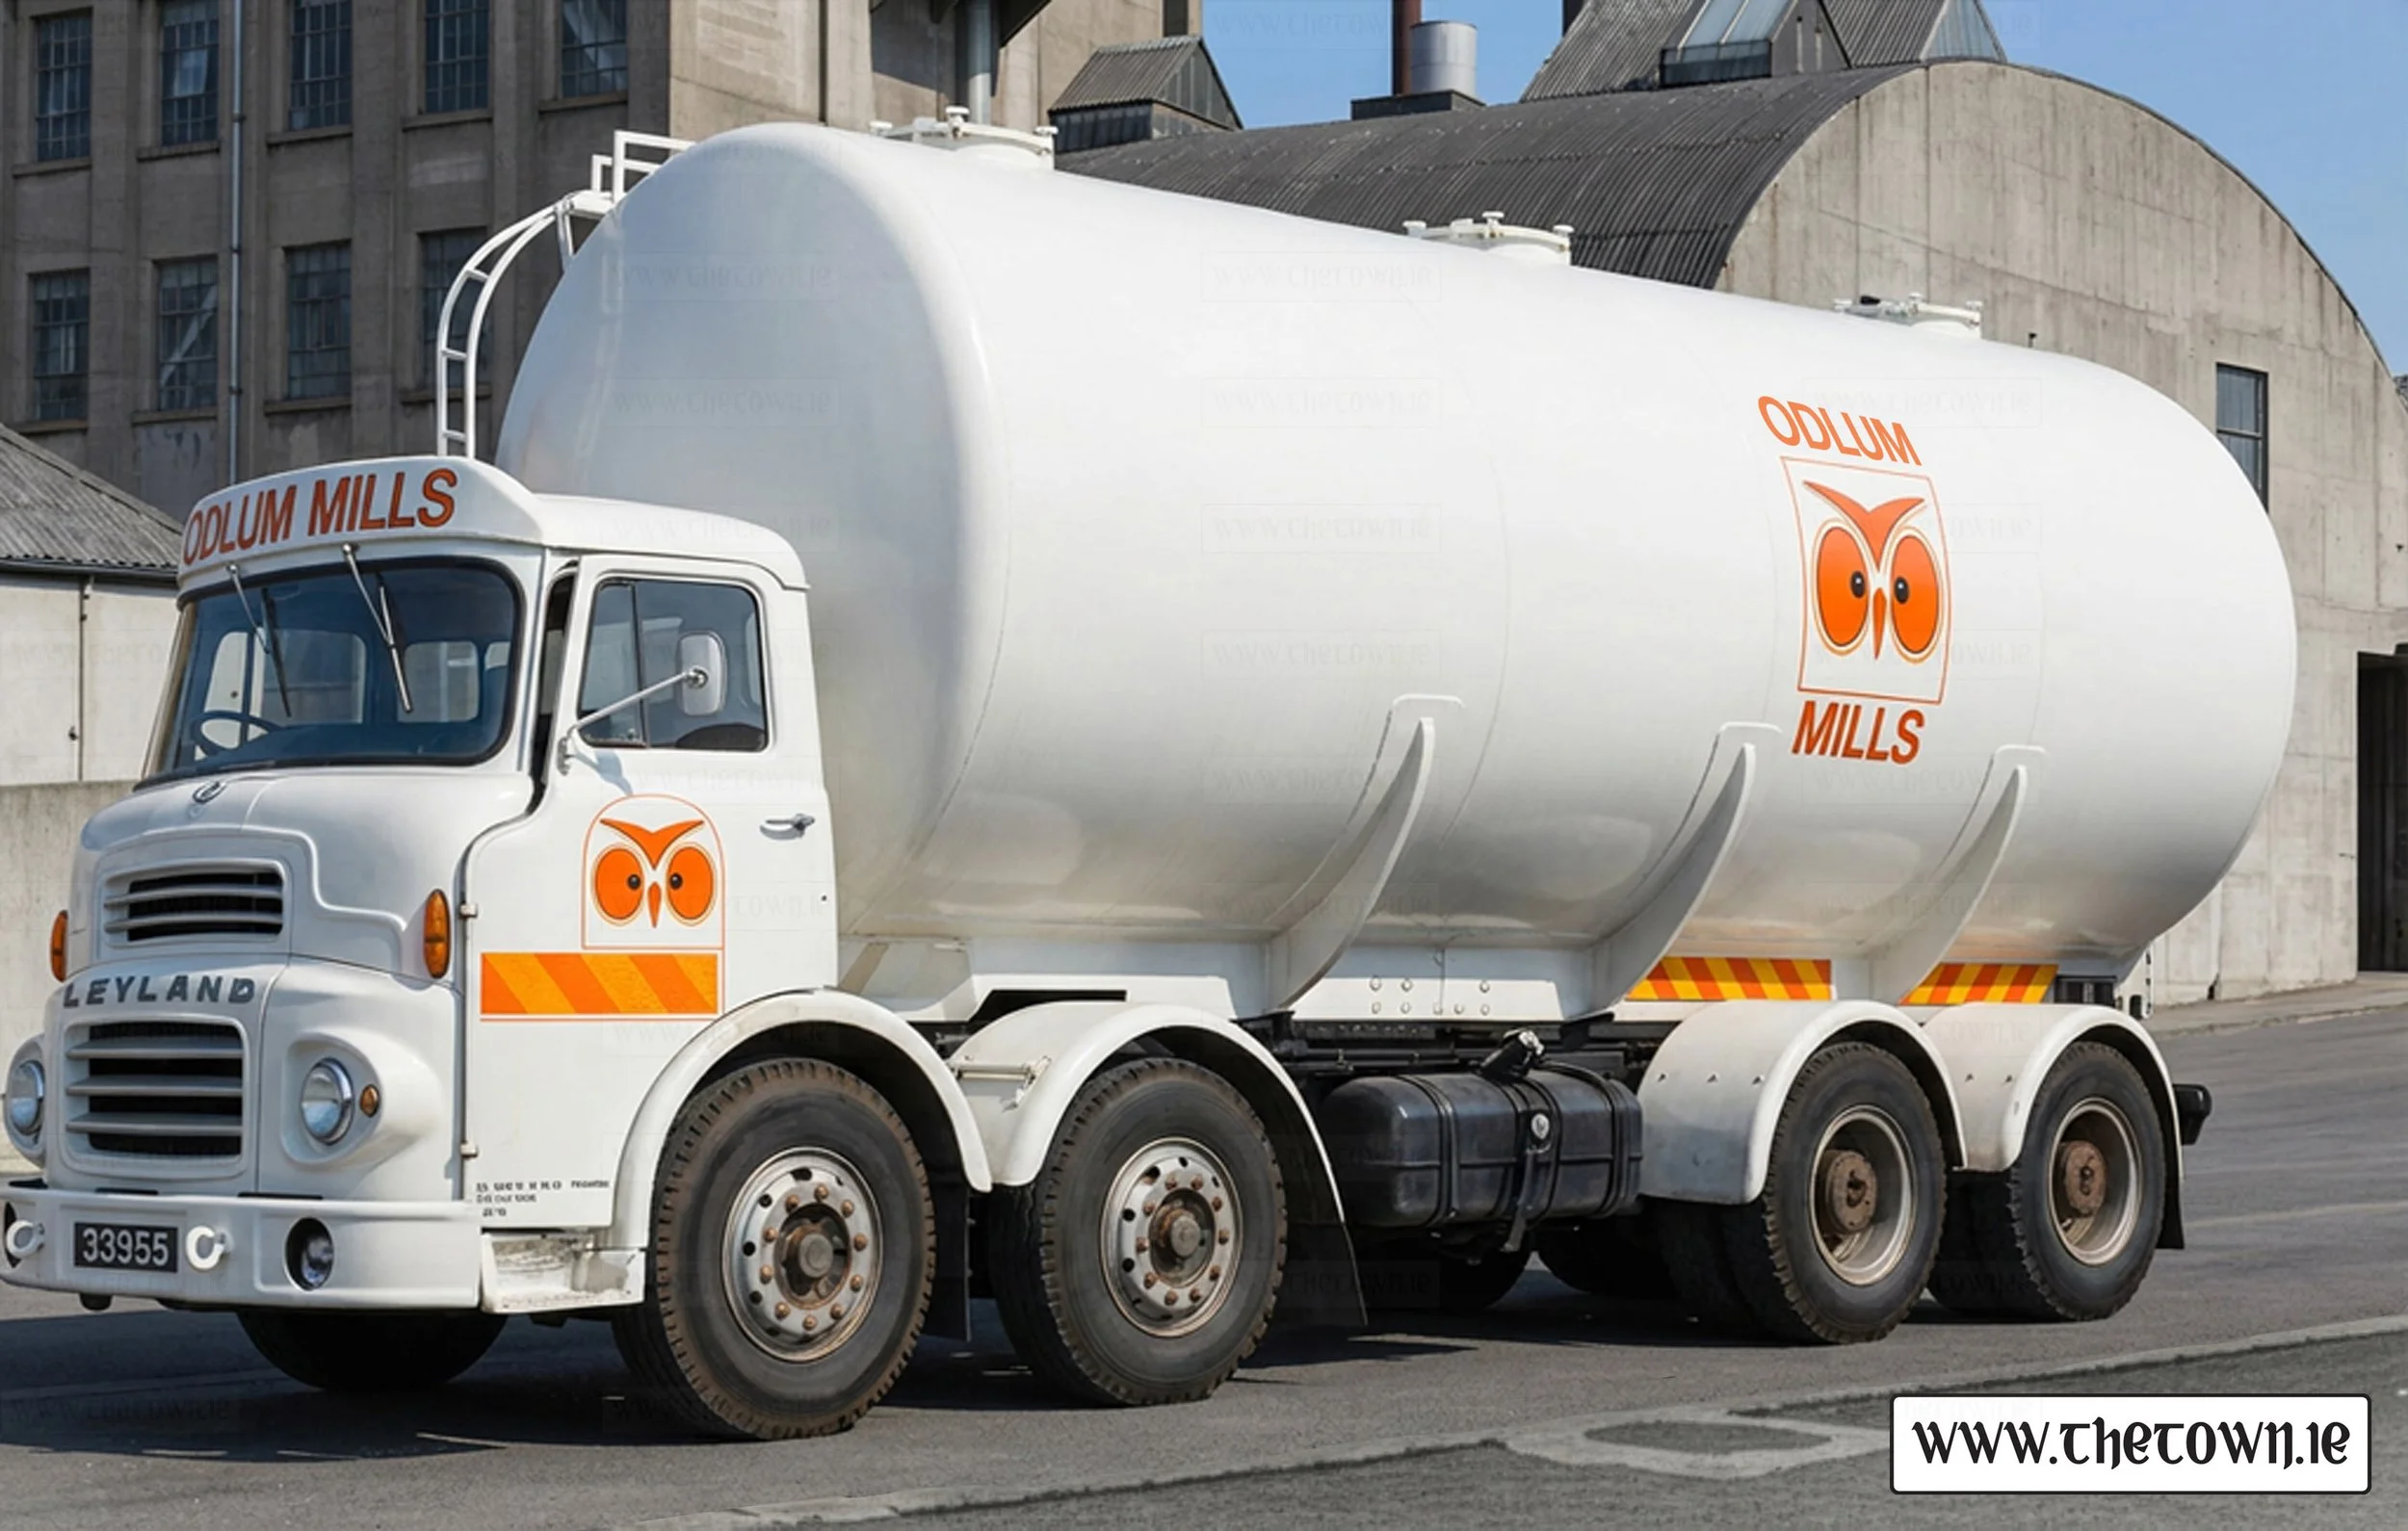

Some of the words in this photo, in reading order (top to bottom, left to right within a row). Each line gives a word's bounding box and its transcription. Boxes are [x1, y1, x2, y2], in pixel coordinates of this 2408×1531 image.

[1758, 396, 1923, 466] ODLUM
[183, 484, 298, 565] ODLUM
[307, 468, 458, 536] MILLS
[1792, 700, 1925, 765] MILLS
[63, 974, 255, 1008] LEYLAND
[83, 1227, 170, 1266] 33955
